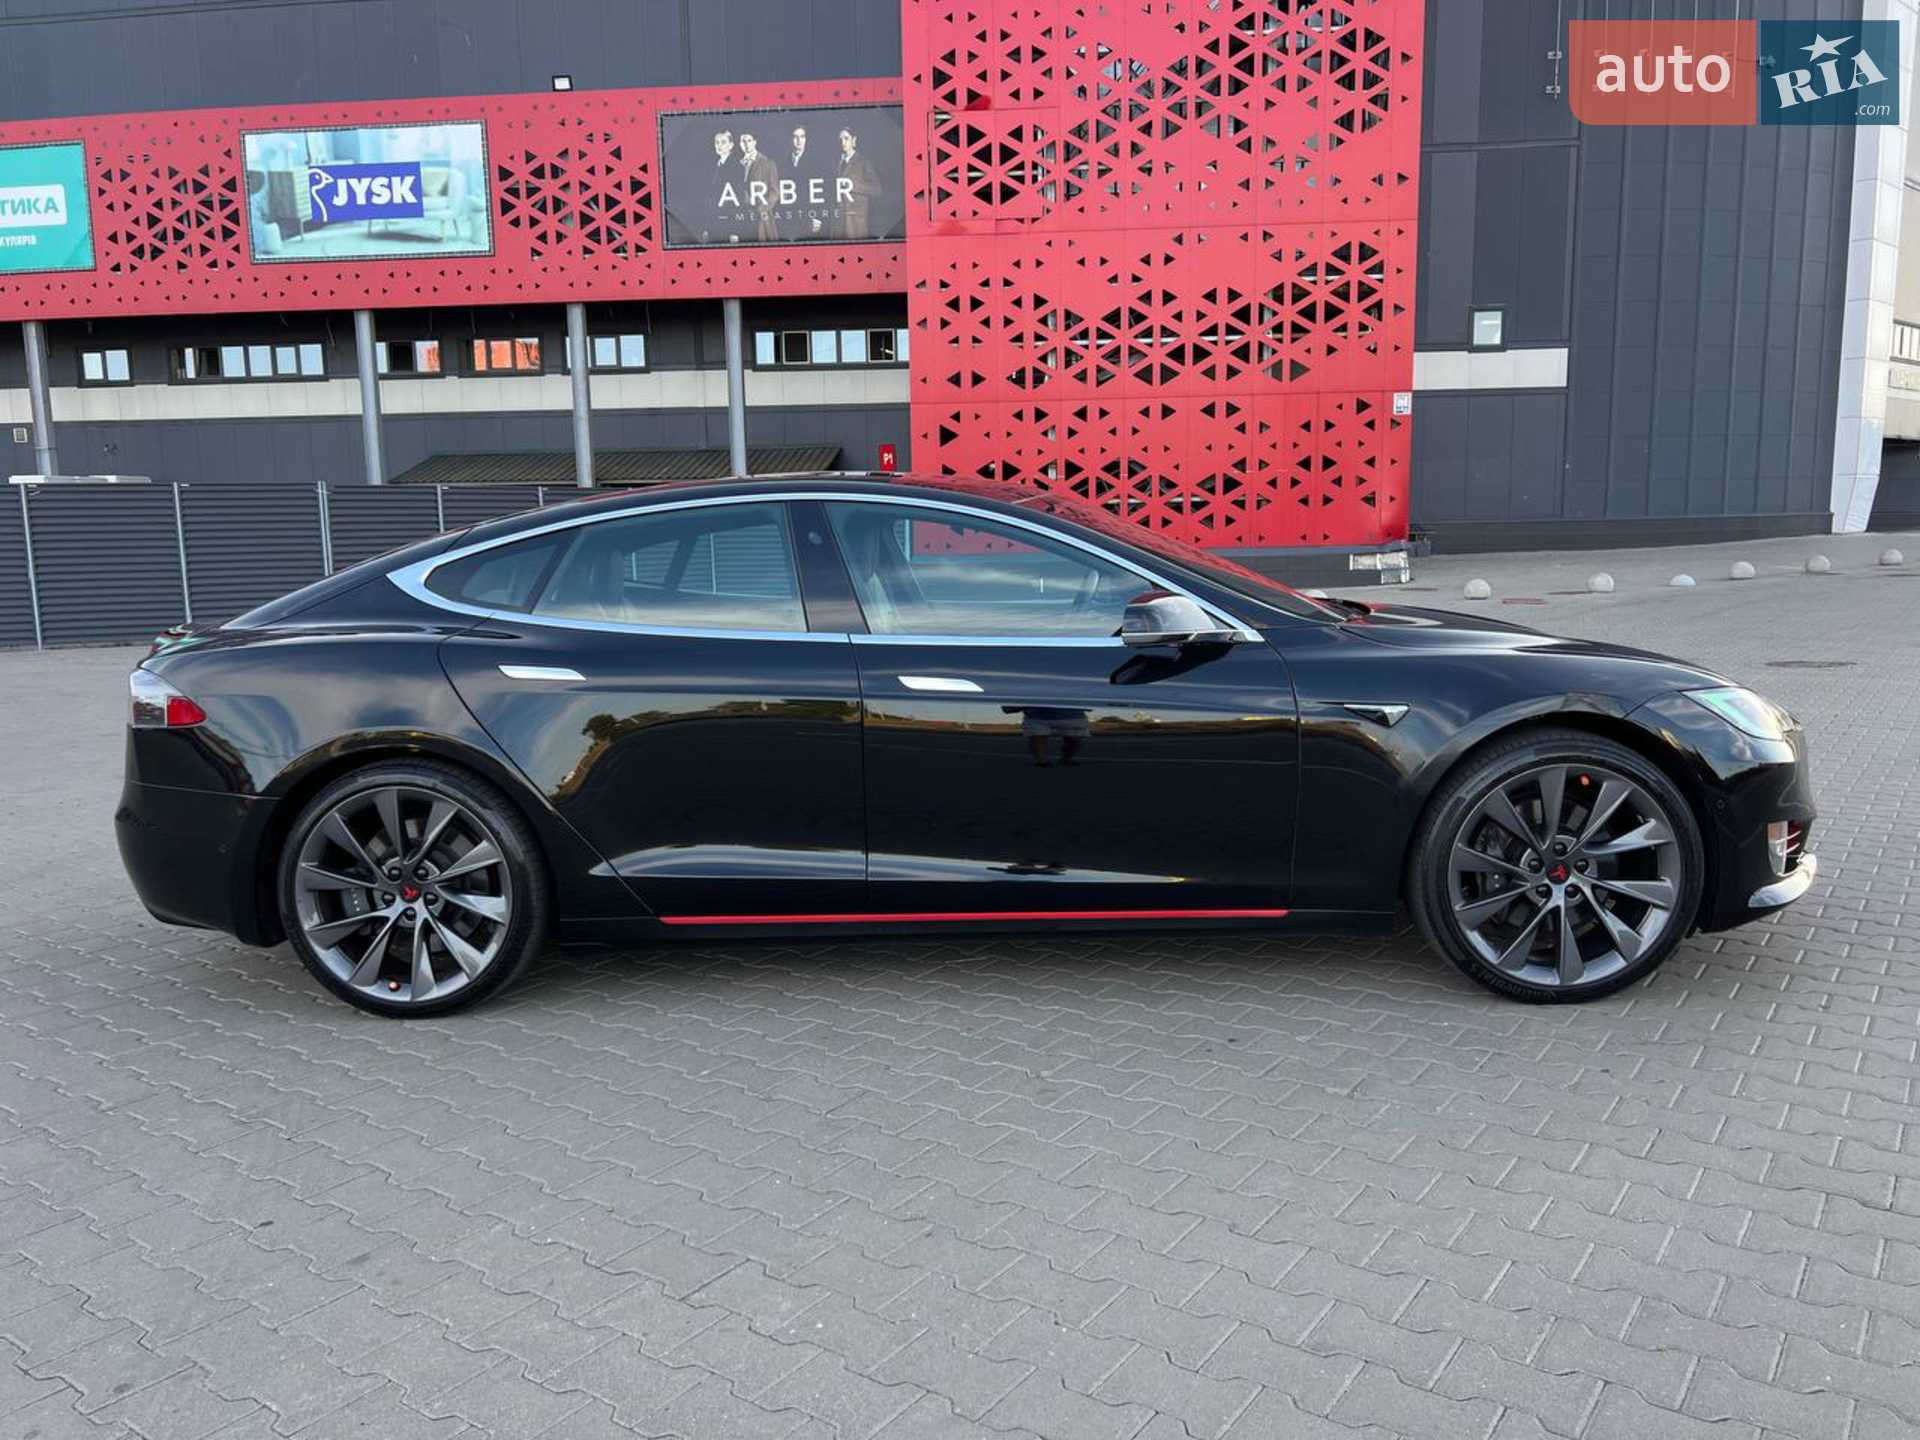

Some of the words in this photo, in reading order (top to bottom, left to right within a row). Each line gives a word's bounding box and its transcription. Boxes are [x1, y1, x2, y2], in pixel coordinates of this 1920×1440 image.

[333, 175, 418, 206] JYSK
[718, 177, 855, 207] ARBER
[734, 208, 840, 221] MEGASTORE
